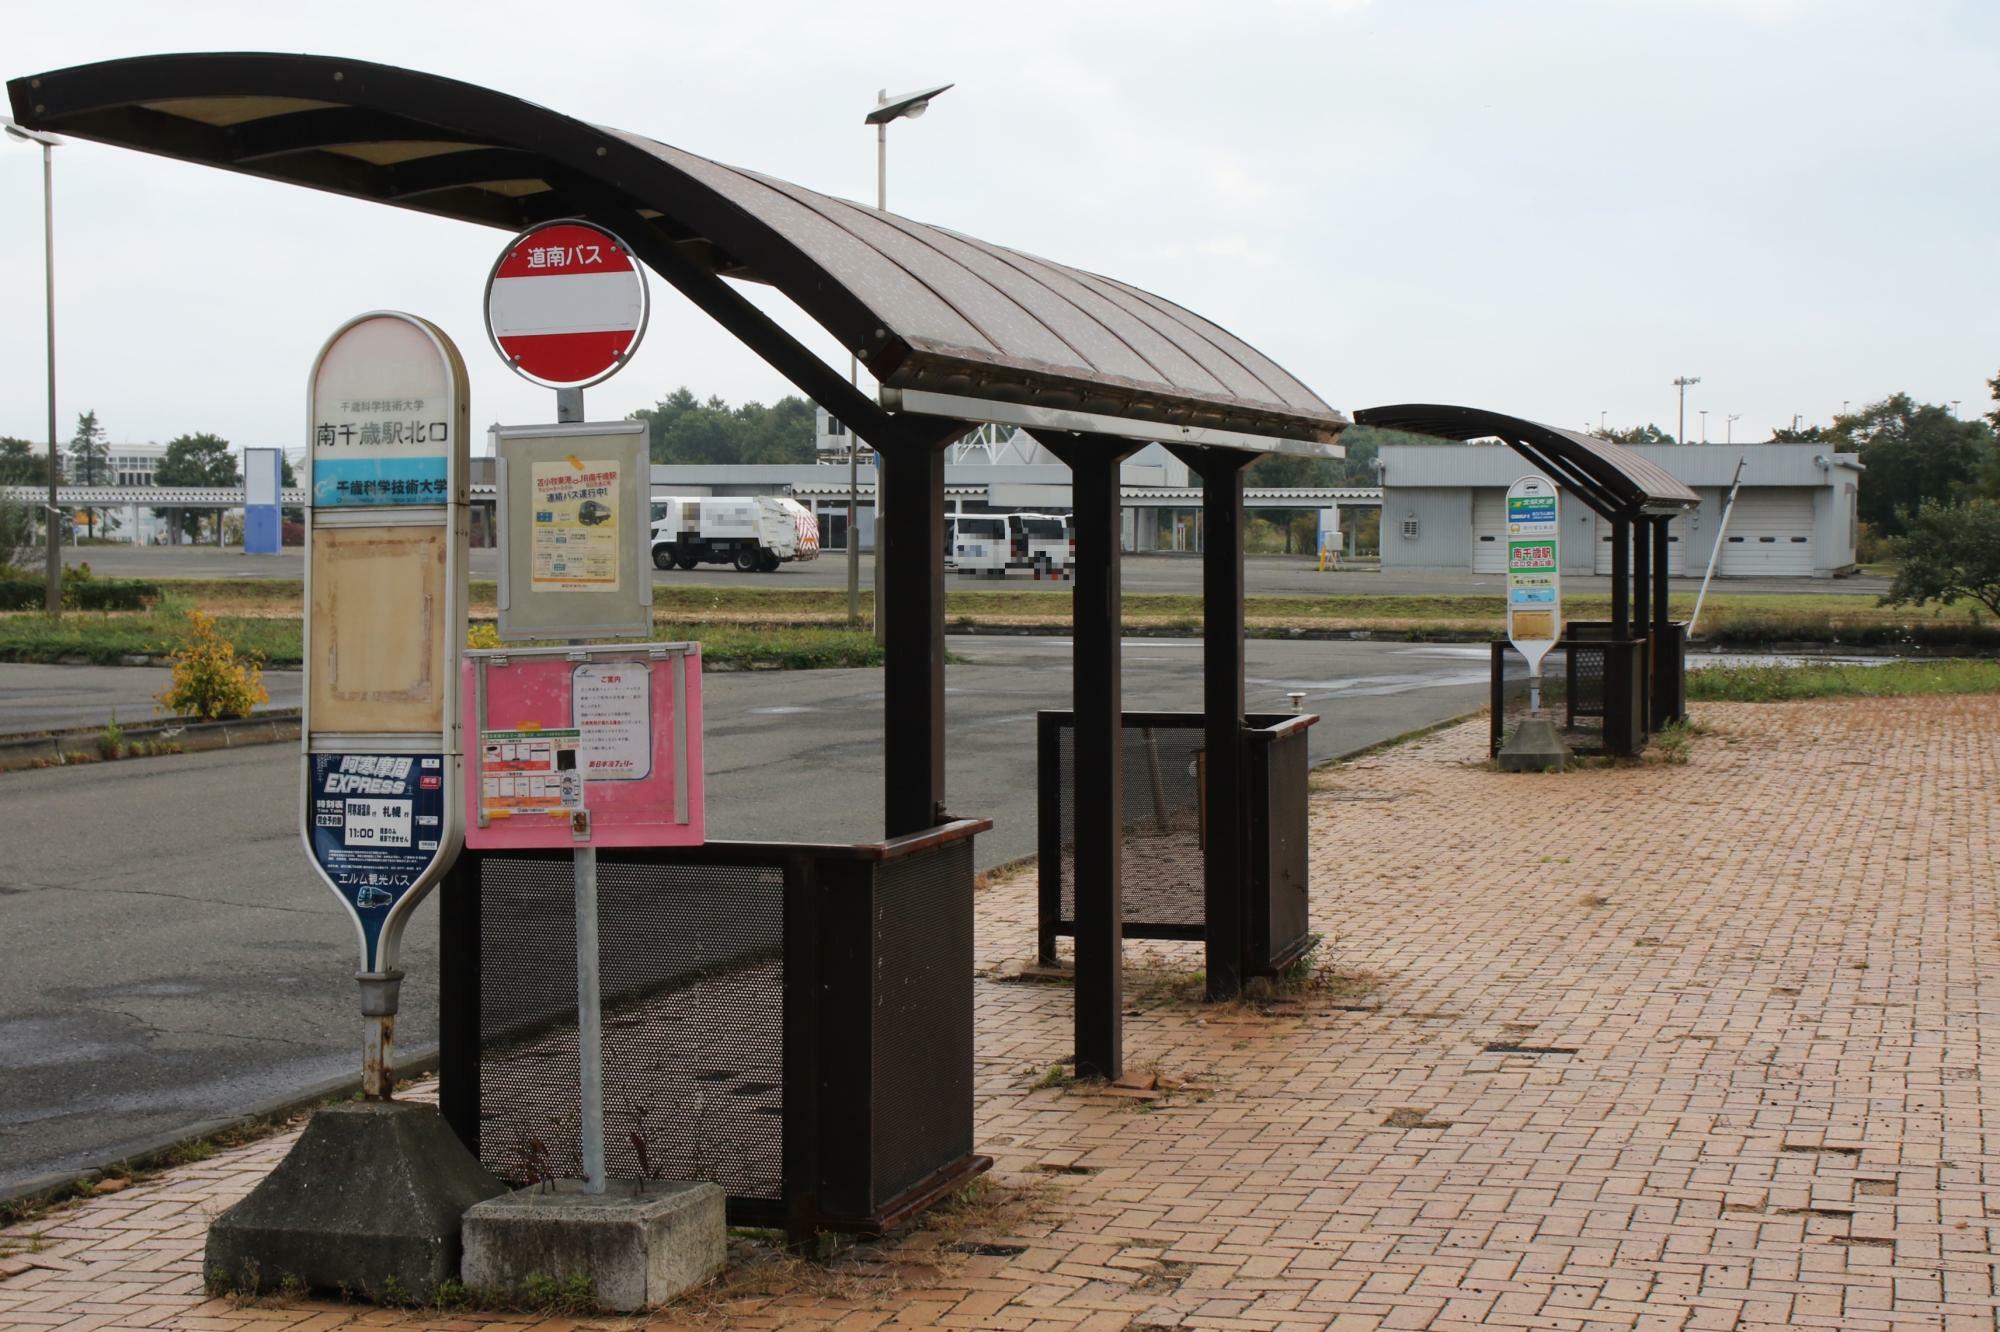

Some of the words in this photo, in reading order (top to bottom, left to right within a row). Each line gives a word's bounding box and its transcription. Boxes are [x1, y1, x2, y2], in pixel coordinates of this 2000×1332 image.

[527, 245, 603, 269] 道南バス
[340, 399, 425, 413] 千歳科学技術大学
[316, 420, 448, 447] 南千歳駅北口
[336, 479, 448, 495] 千歳科学技術大学
[1514, 547, 1551, 559] 南千歳駅
[324, 773, 406, 794] EXPRESS
[316, 800, 343, 808] 時刻表
[383, 805, 401, 818] 札幌
[349, 828, 374, 839] 11:00
[339, 873, 410, 886] エルム観光バス
